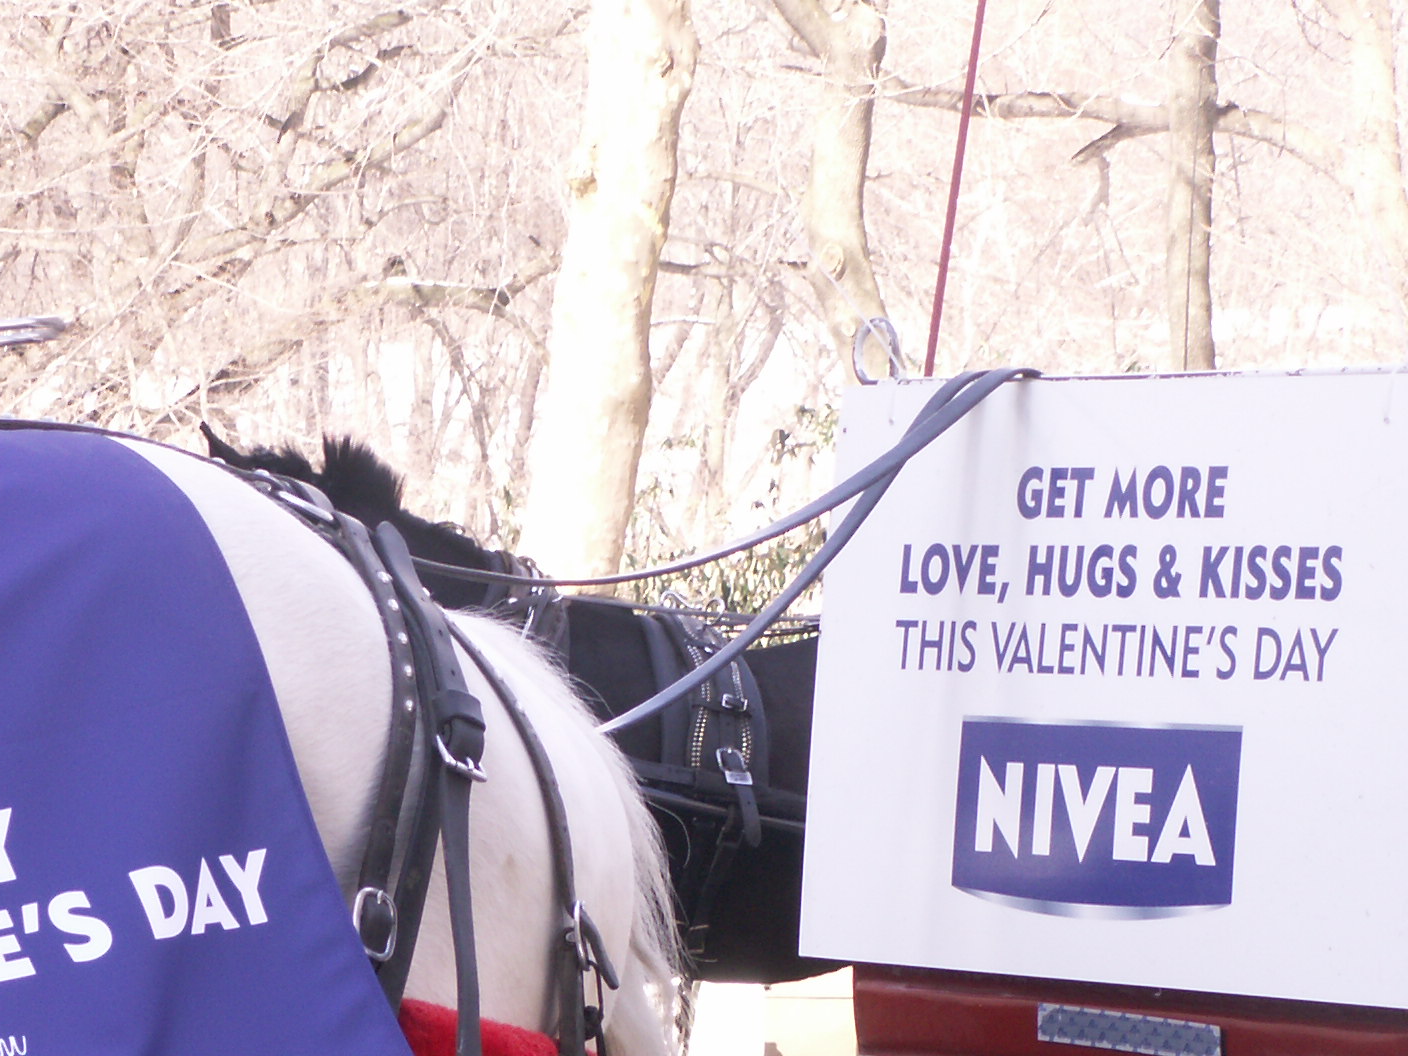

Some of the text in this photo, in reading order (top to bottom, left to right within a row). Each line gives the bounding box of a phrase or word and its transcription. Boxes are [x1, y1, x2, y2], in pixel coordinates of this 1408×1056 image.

[1016, 464, 1229, 521] GET MORE
[898, 542, 1344, 604] LOVE, HUGS & KISSES
[895, 619, 1340, 683] THIS VALENTINE'S DAY
[973, 754, 1217, 867] NIVEA
[128, 847, 269, 940] DAY
